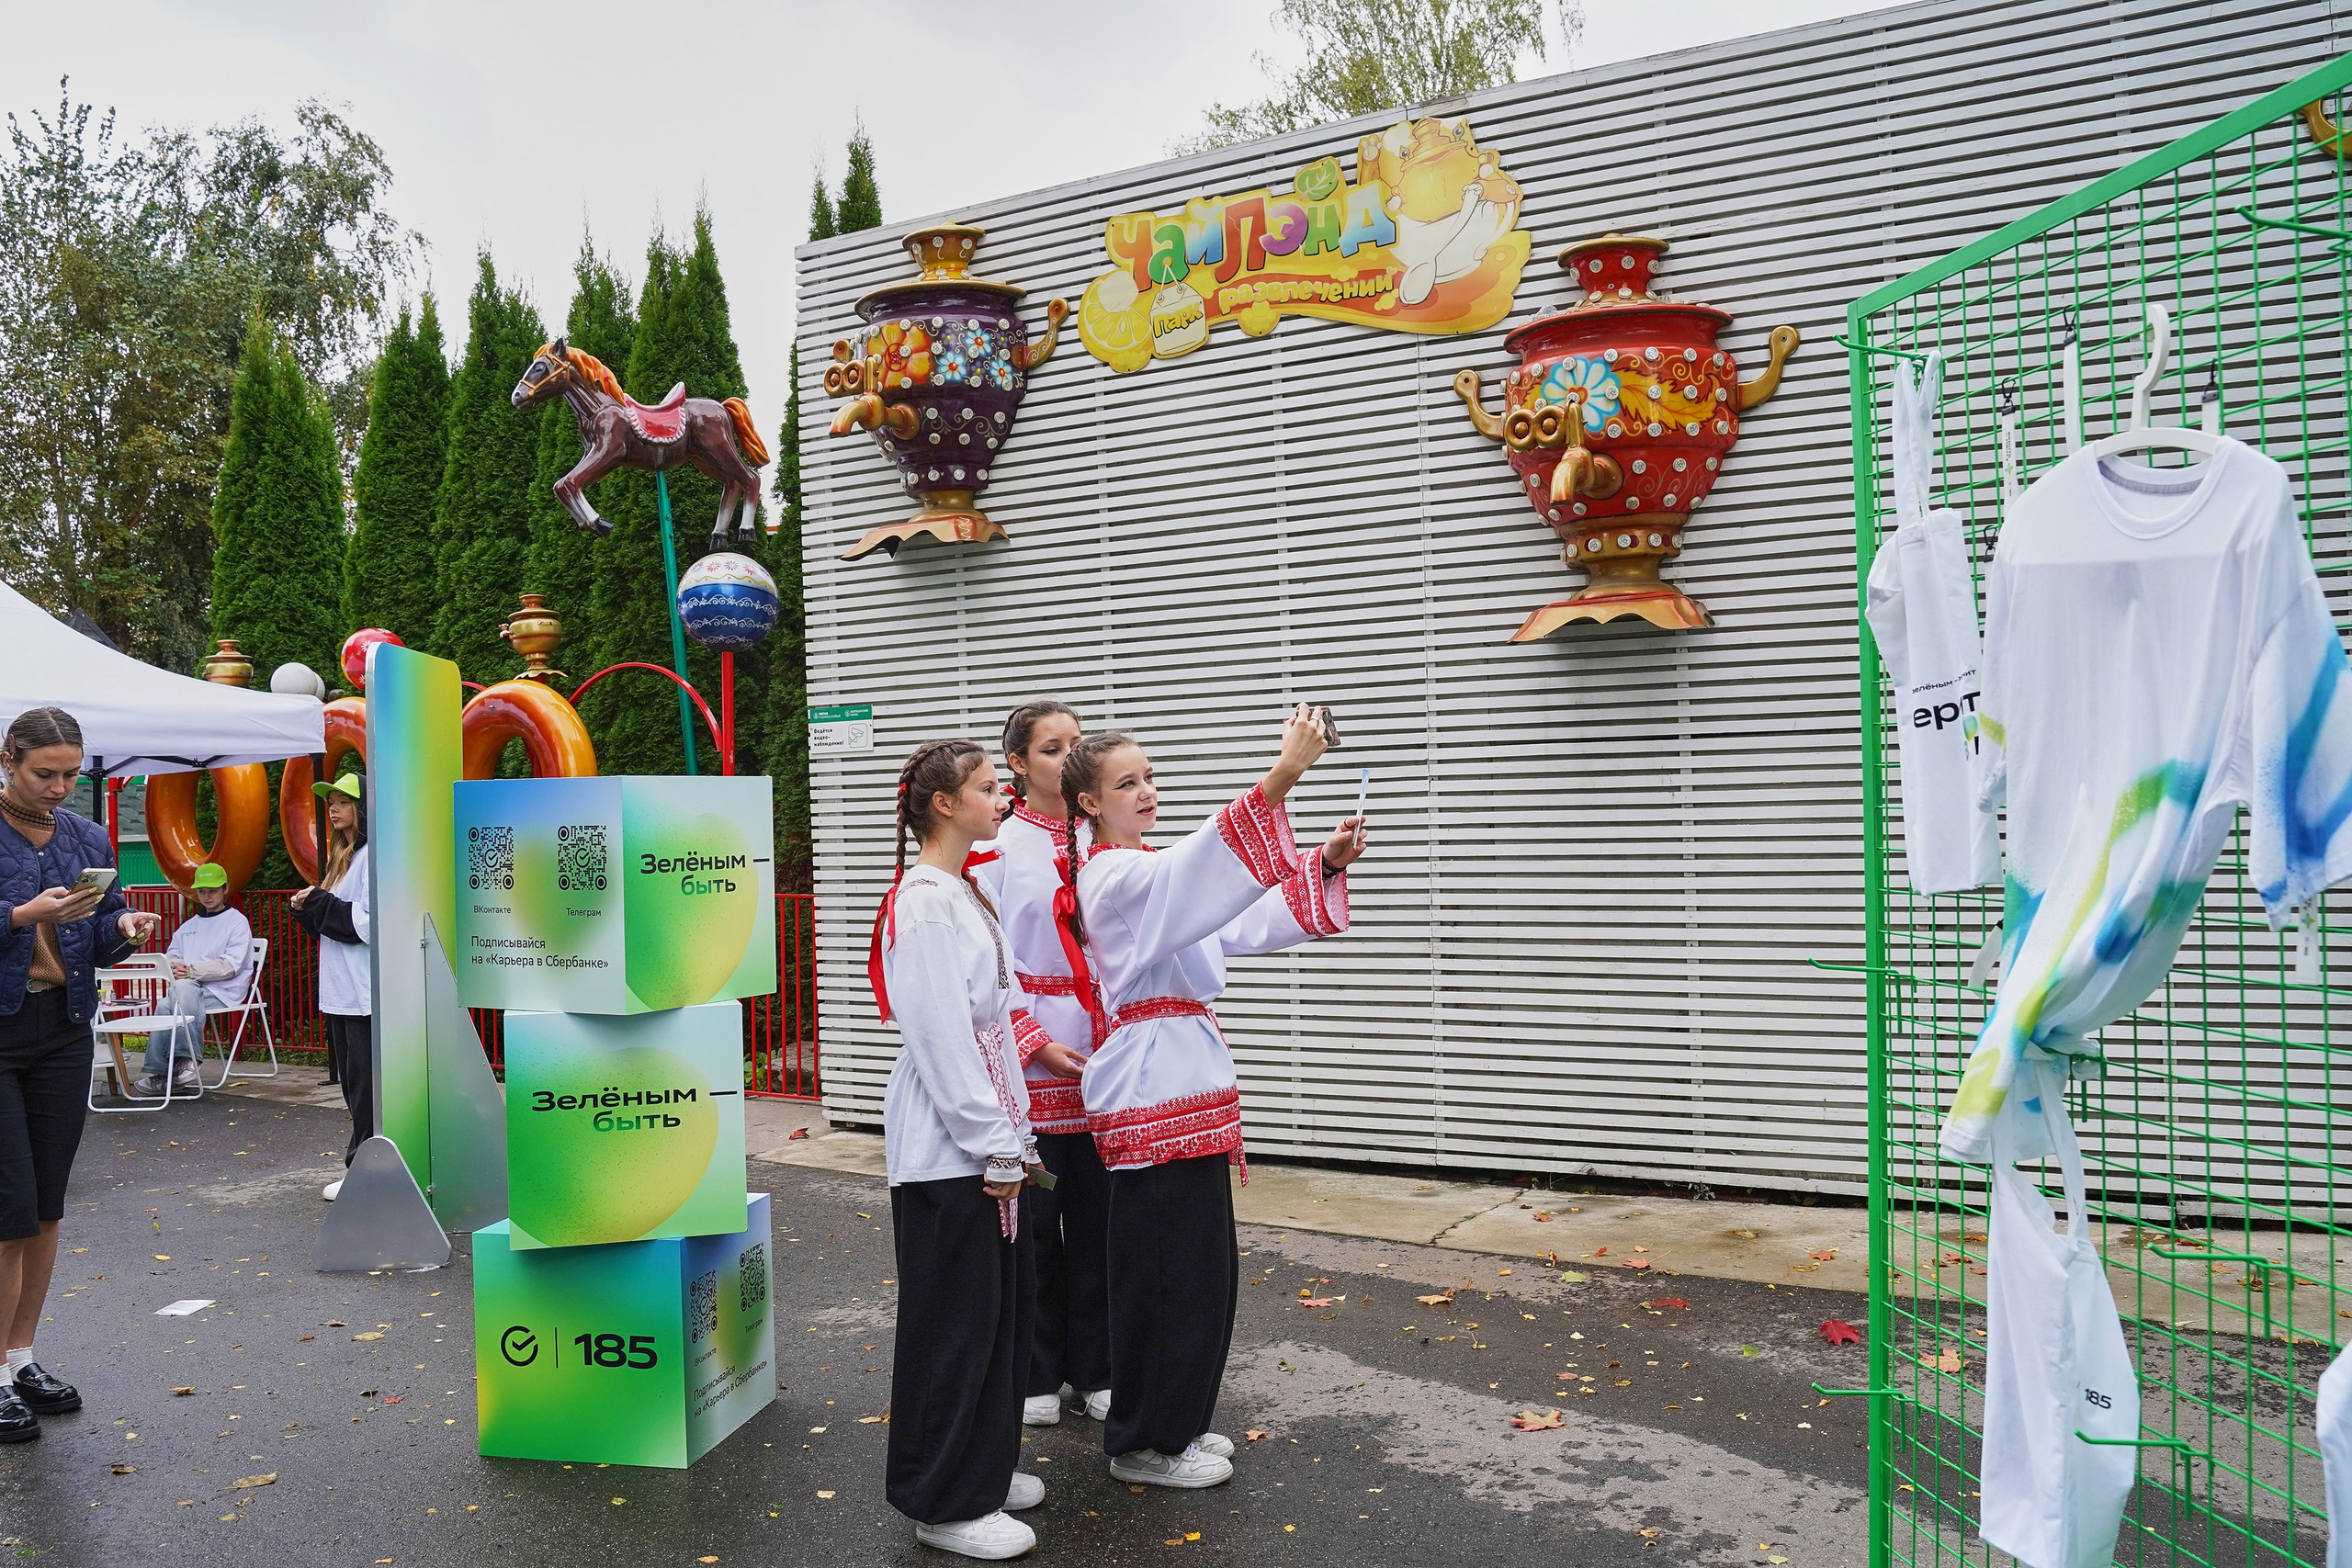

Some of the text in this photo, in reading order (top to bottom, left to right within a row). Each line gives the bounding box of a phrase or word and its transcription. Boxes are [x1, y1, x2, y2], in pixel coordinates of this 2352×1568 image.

[1219, 267, 1398, 315] развлечений
[640, 851, 746, 874] Зелёным
[681, 874, 737, 897] быть
[473, 905, 512, 915] ВКонтакте
[566, 908, 602, 918] Телеграм
[471, 935, 546, 952] Подписывайся
[471, 953, 609, 970] на «Карьера в Сбербанке»
[531, 1087, 697, 1112] Зелёным
[593, 1110, 682, 1133] быть
[574, 1332, 659, 1371] 185
[694, 1347, 717, 1367] ВКонтакте
[694, 1364, 736, 1402] Подписывайся
[2084, 1387, 2112, 1410] 185
[694, 1406, 702, 1418] на
